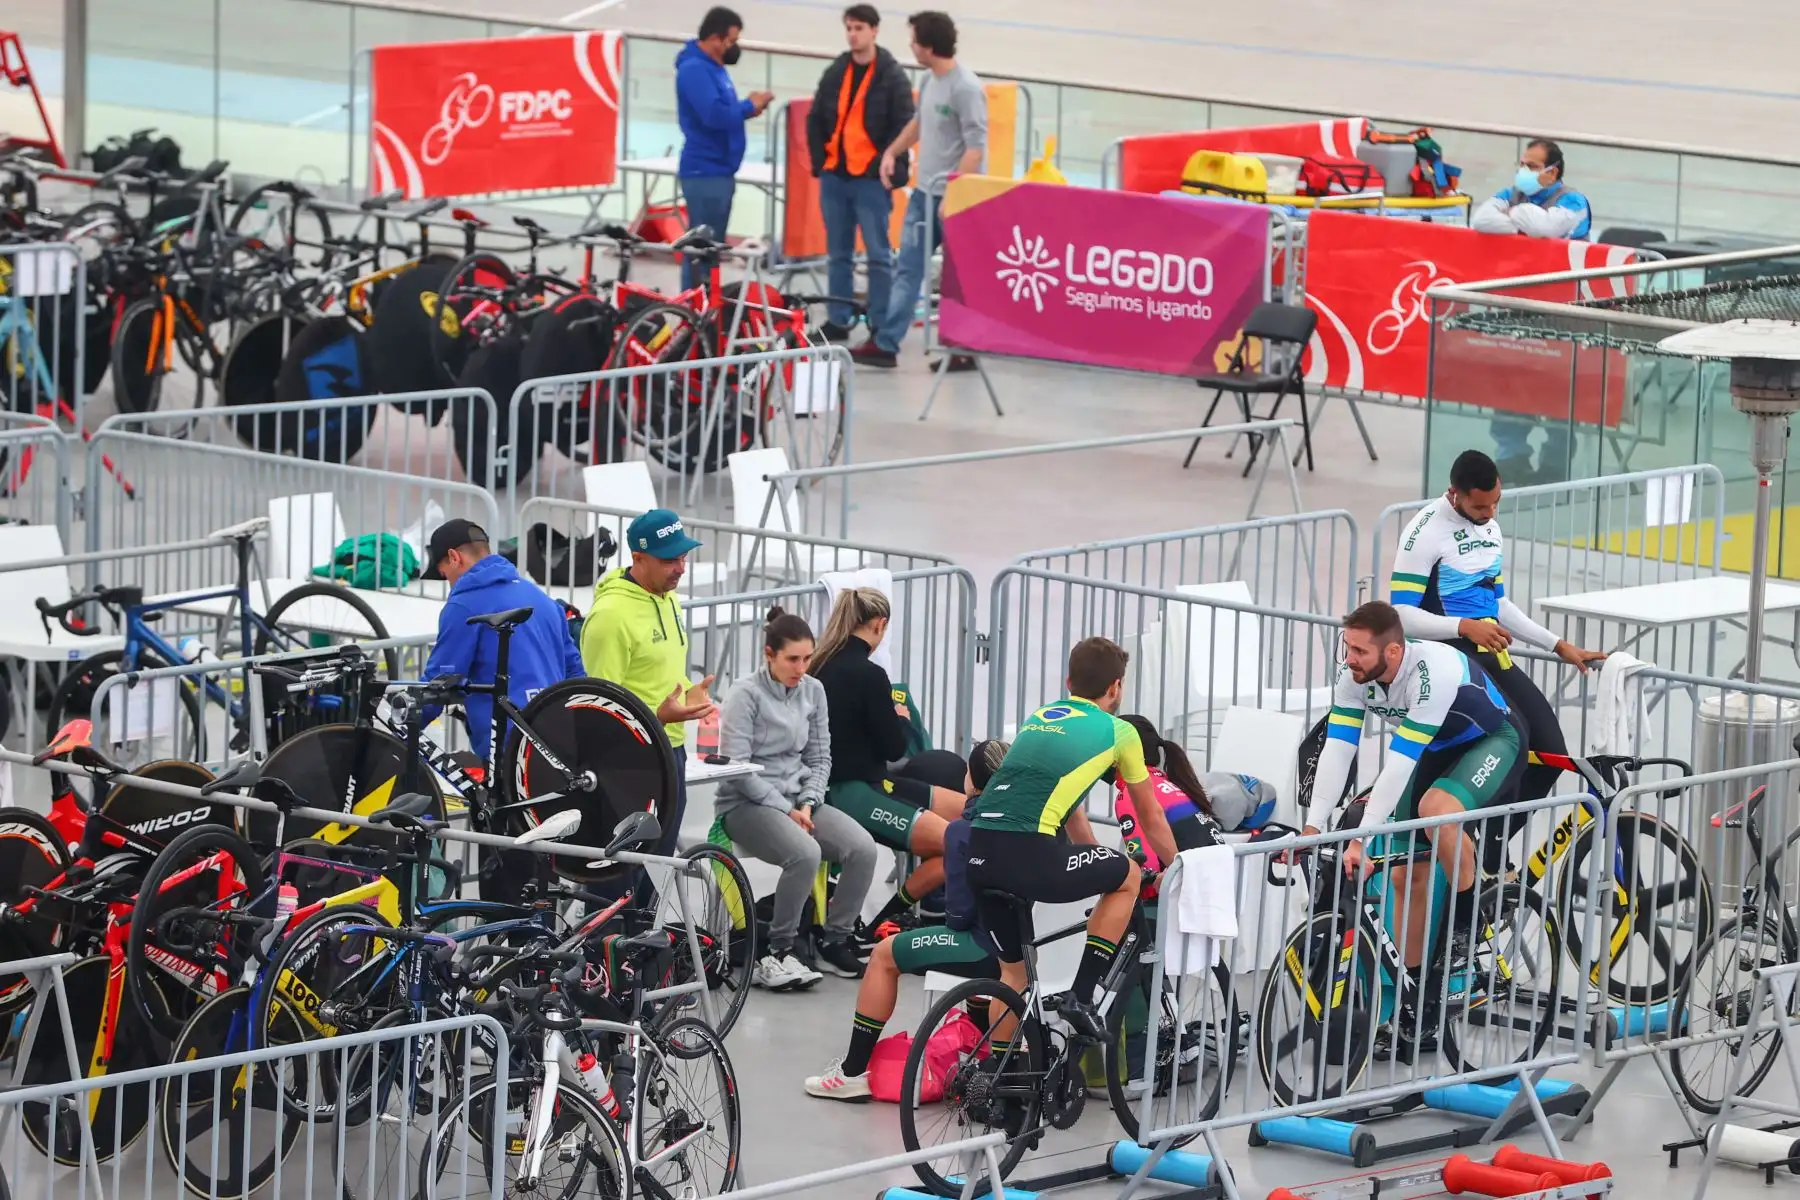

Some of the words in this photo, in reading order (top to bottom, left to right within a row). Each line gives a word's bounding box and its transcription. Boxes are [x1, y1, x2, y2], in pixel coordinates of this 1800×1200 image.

[499, 88, 573, 123] FDPC
[1065, 286, 1143, 313] Seguimos
[1147, 297, 1212, 322] jugando
[1404, 510, 1435, 551] BRASIL
[1417, 659, 1432, 705] BRASIL
[1471, 754, 1501, 788] BRASIL
[1066, 846, 1119, 872] BRASIL
[911, 933, 960, 949] BRASIL
